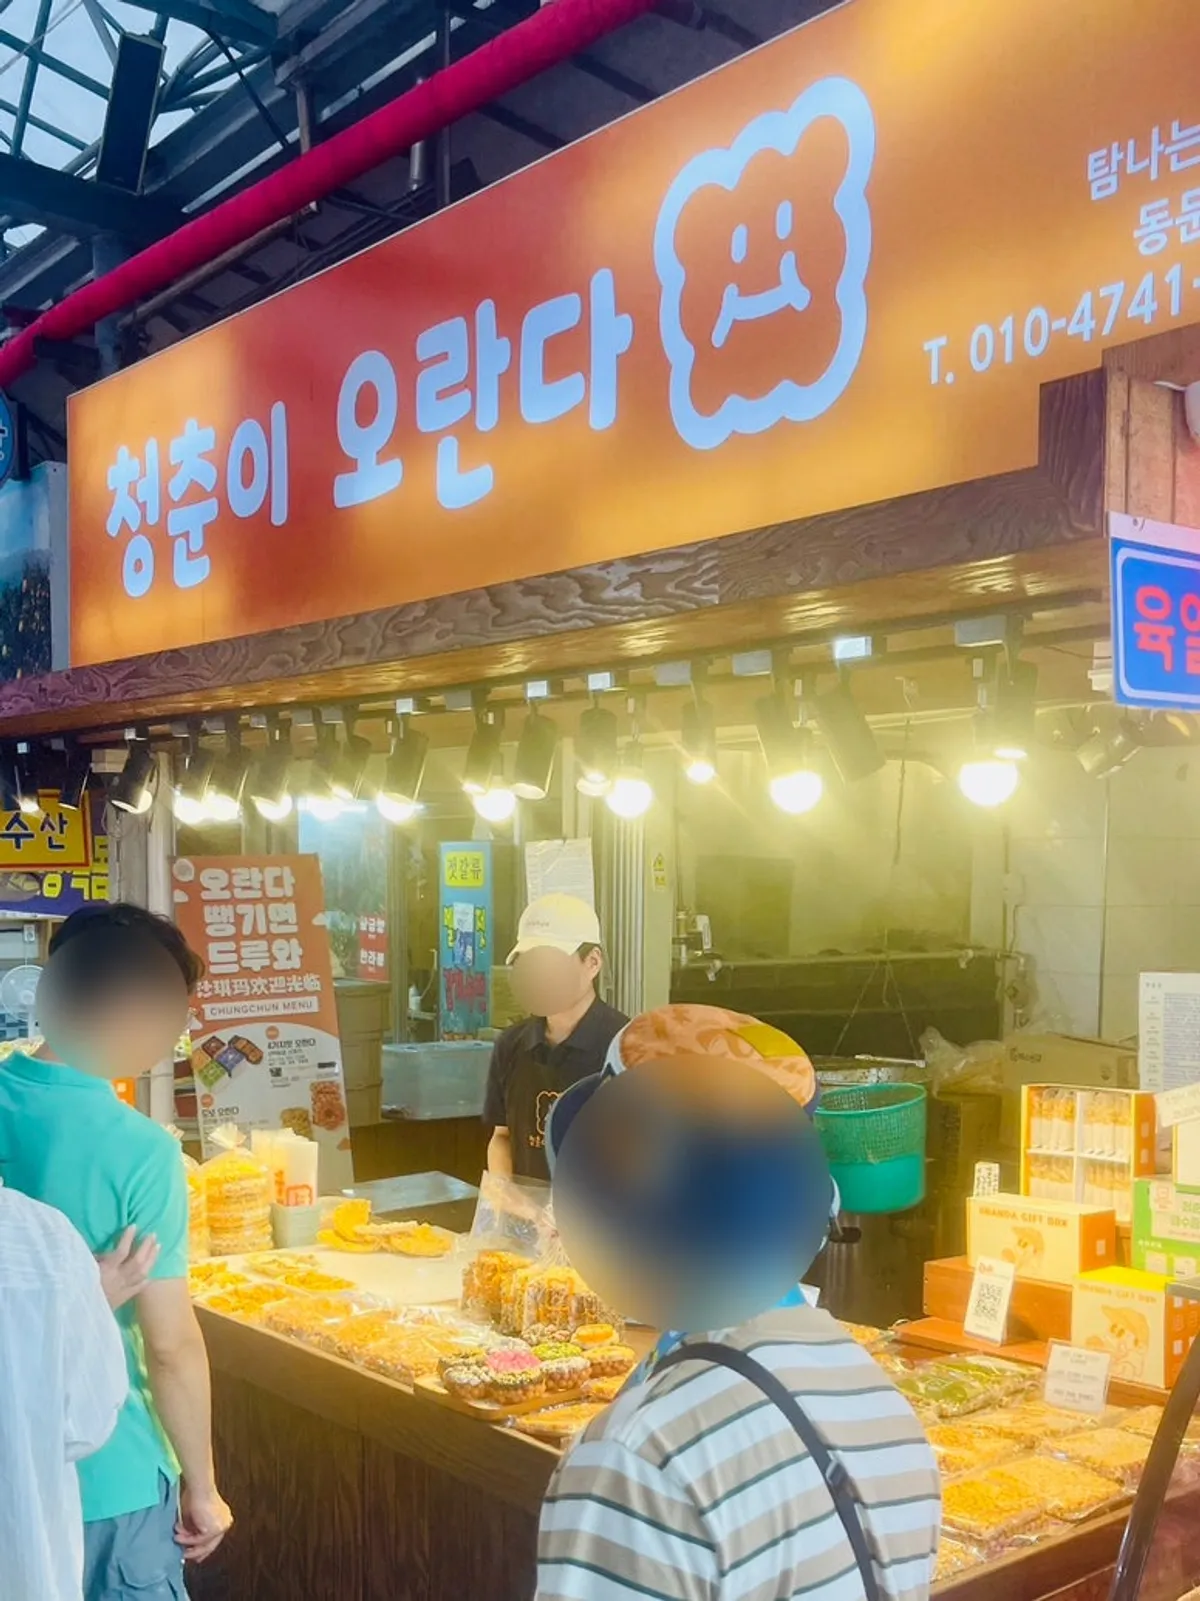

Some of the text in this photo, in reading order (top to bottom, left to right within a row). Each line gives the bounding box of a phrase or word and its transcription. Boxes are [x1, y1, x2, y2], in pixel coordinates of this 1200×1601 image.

[1087, 118, 1200, 200] 탐나는
[923, 335, 955, 384] T.
[105, 267, 633, 598] 청춘이 오란다
[0, 811, 68, 850] 수산
[200, 866, 296, 900] 오란다
[447, 856, 482, 881] 젓갈류
[208, 937, 303, 974] 드루와
[210, 1001, 313, 1016] CHUNGCHUN MENU
[1021, 1213, 1044, 1225] GIFT
